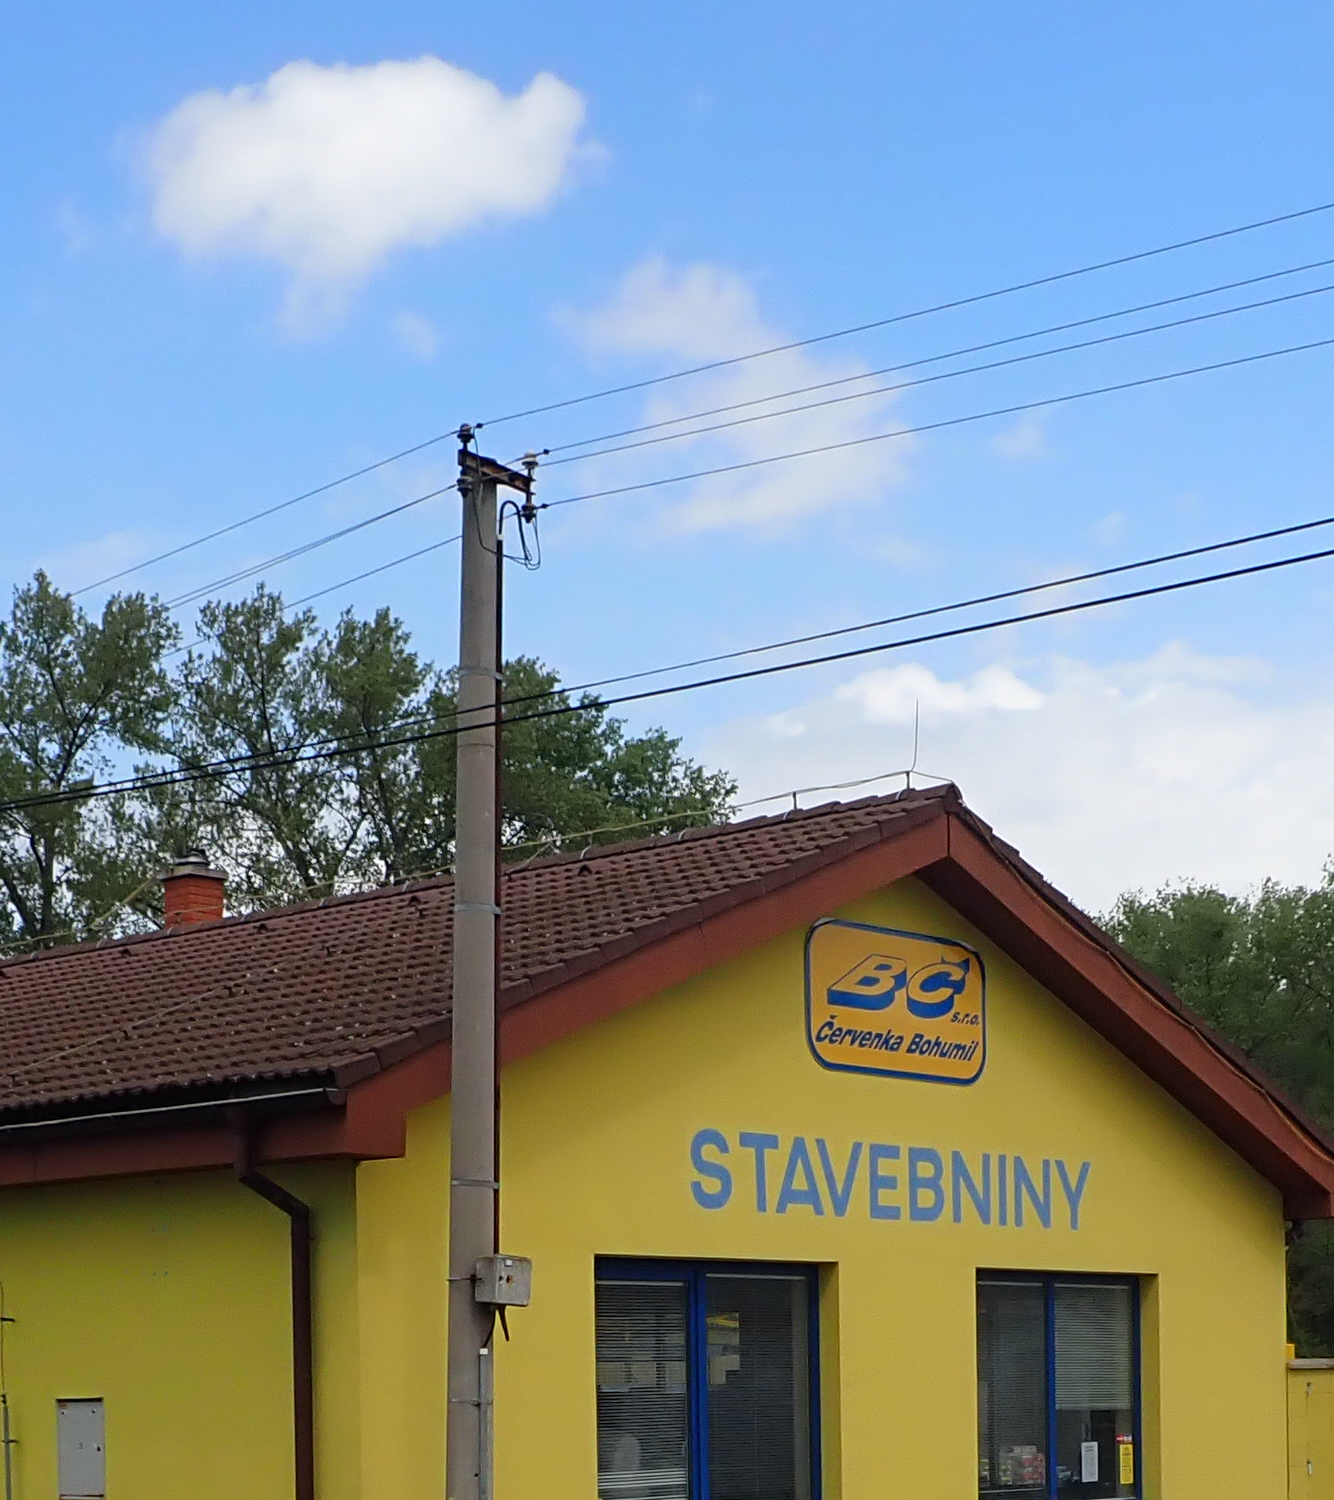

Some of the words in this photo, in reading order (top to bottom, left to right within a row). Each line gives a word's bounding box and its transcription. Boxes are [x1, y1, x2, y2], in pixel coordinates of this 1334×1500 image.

[815, 1014, 905, 1052] Červenka
[906, 1033, 979, 1062] Bohumil
[951, 1012, 980, 1026] s.r.o.
[690, 1128, 1091, 1231] STAVEBNINY
